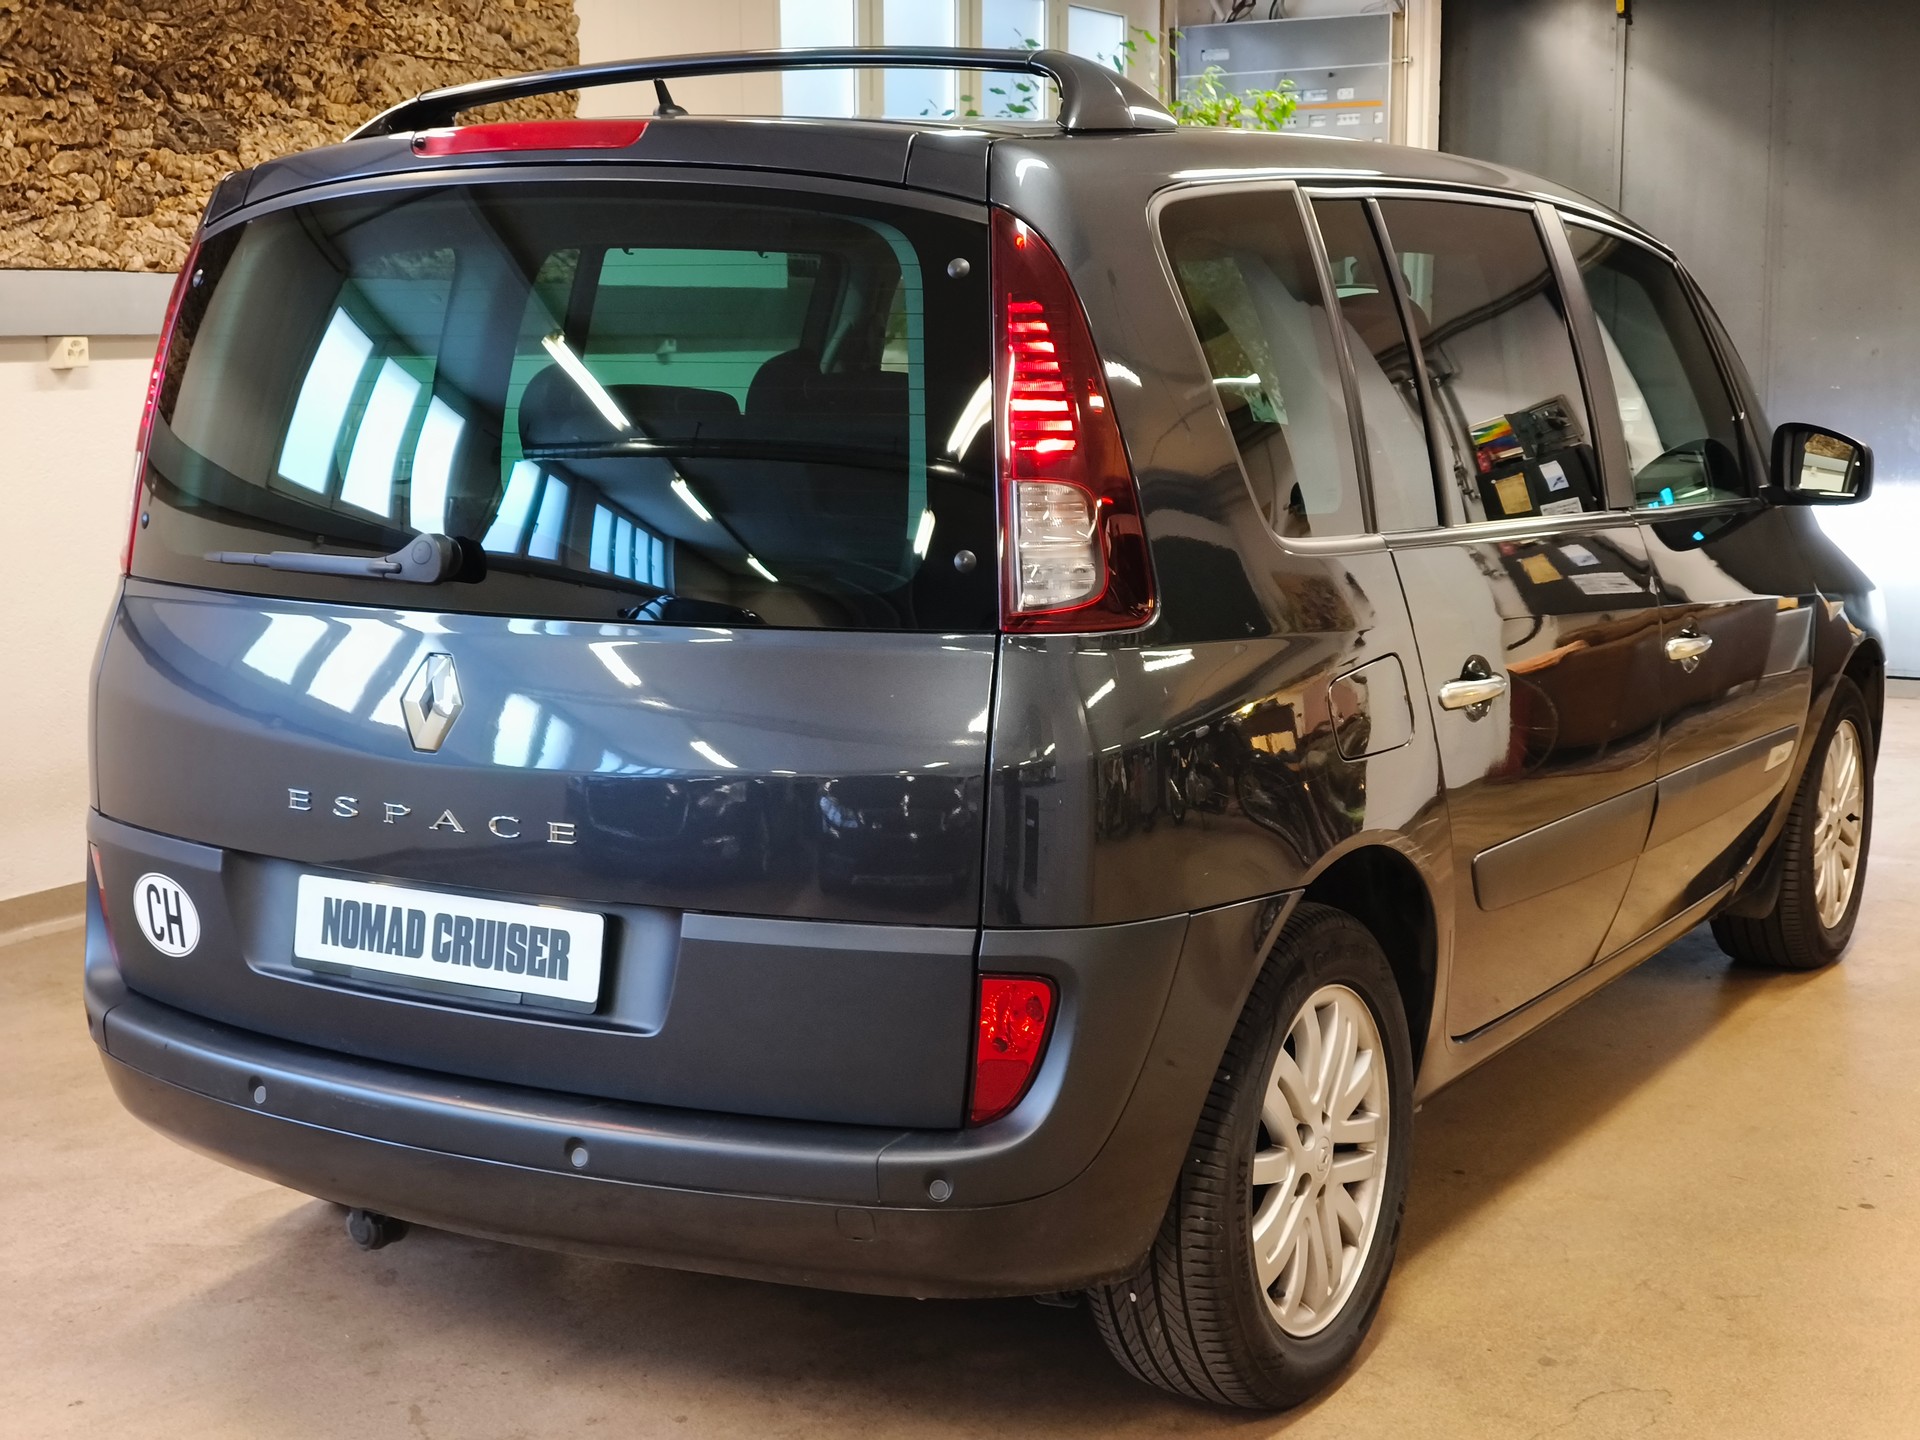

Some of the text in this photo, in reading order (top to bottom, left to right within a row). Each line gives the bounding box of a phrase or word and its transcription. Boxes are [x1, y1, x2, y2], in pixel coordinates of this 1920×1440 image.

[288, 788, 577, 845] ESPACE
[146, 883, 186, 949] CH
[321, 896, 571, 981] NOMAD CRUISER
[1236, 1157, 1249, 1204] NXT
